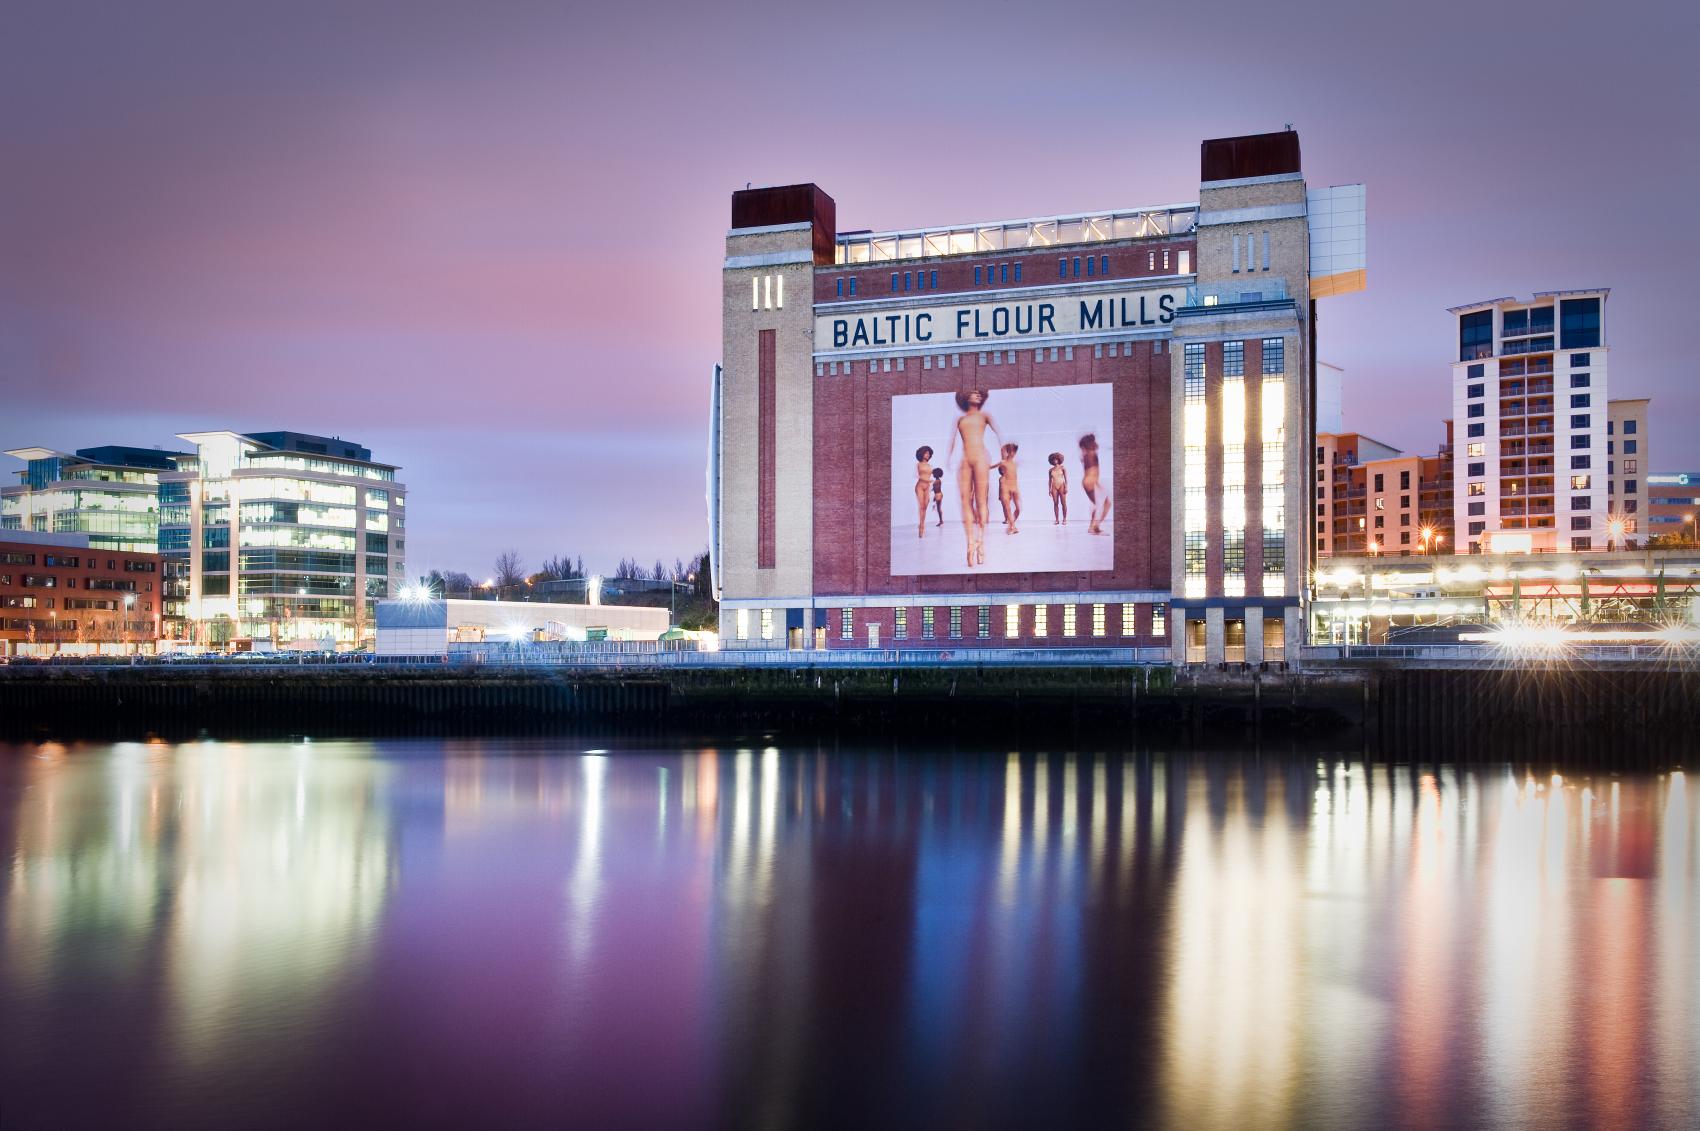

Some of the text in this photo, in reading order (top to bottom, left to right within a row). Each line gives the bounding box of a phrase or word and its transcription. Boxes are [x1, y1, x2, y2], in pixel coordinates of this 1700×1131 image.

[833, 294, 1175, 347] BALTIC FLOUR MILLS
